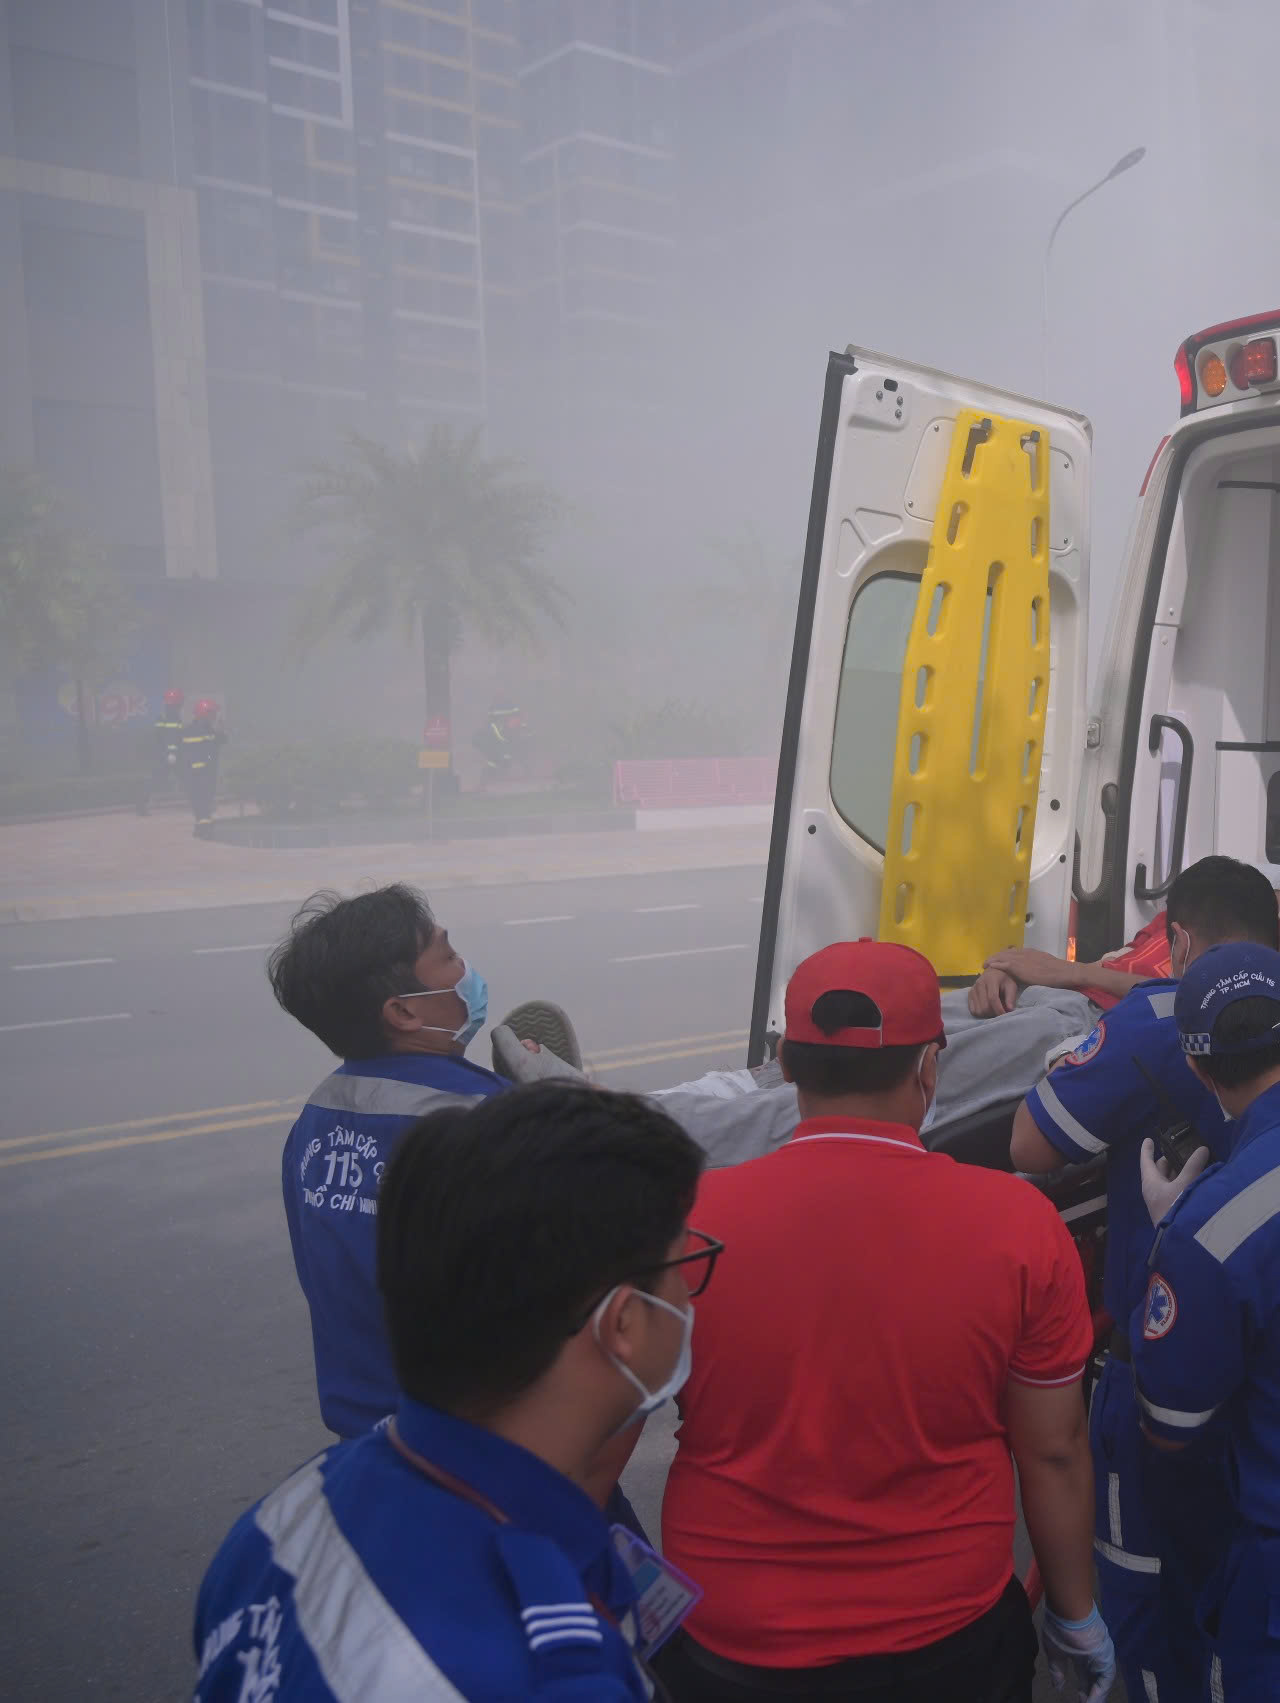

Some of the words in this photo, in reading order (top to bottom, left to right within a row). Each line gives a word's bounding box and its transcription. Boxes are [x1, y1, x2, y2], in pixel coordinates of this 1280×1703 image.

[1200, 988, 1217, 1009] TRUNG
[1233, 970, 1249, 981] CẤP
[328, 1125, 355, 1147] TÂM
[324, 1150, 363, 1188] 115
[330, 1189, 358, 1211] CHÍ
